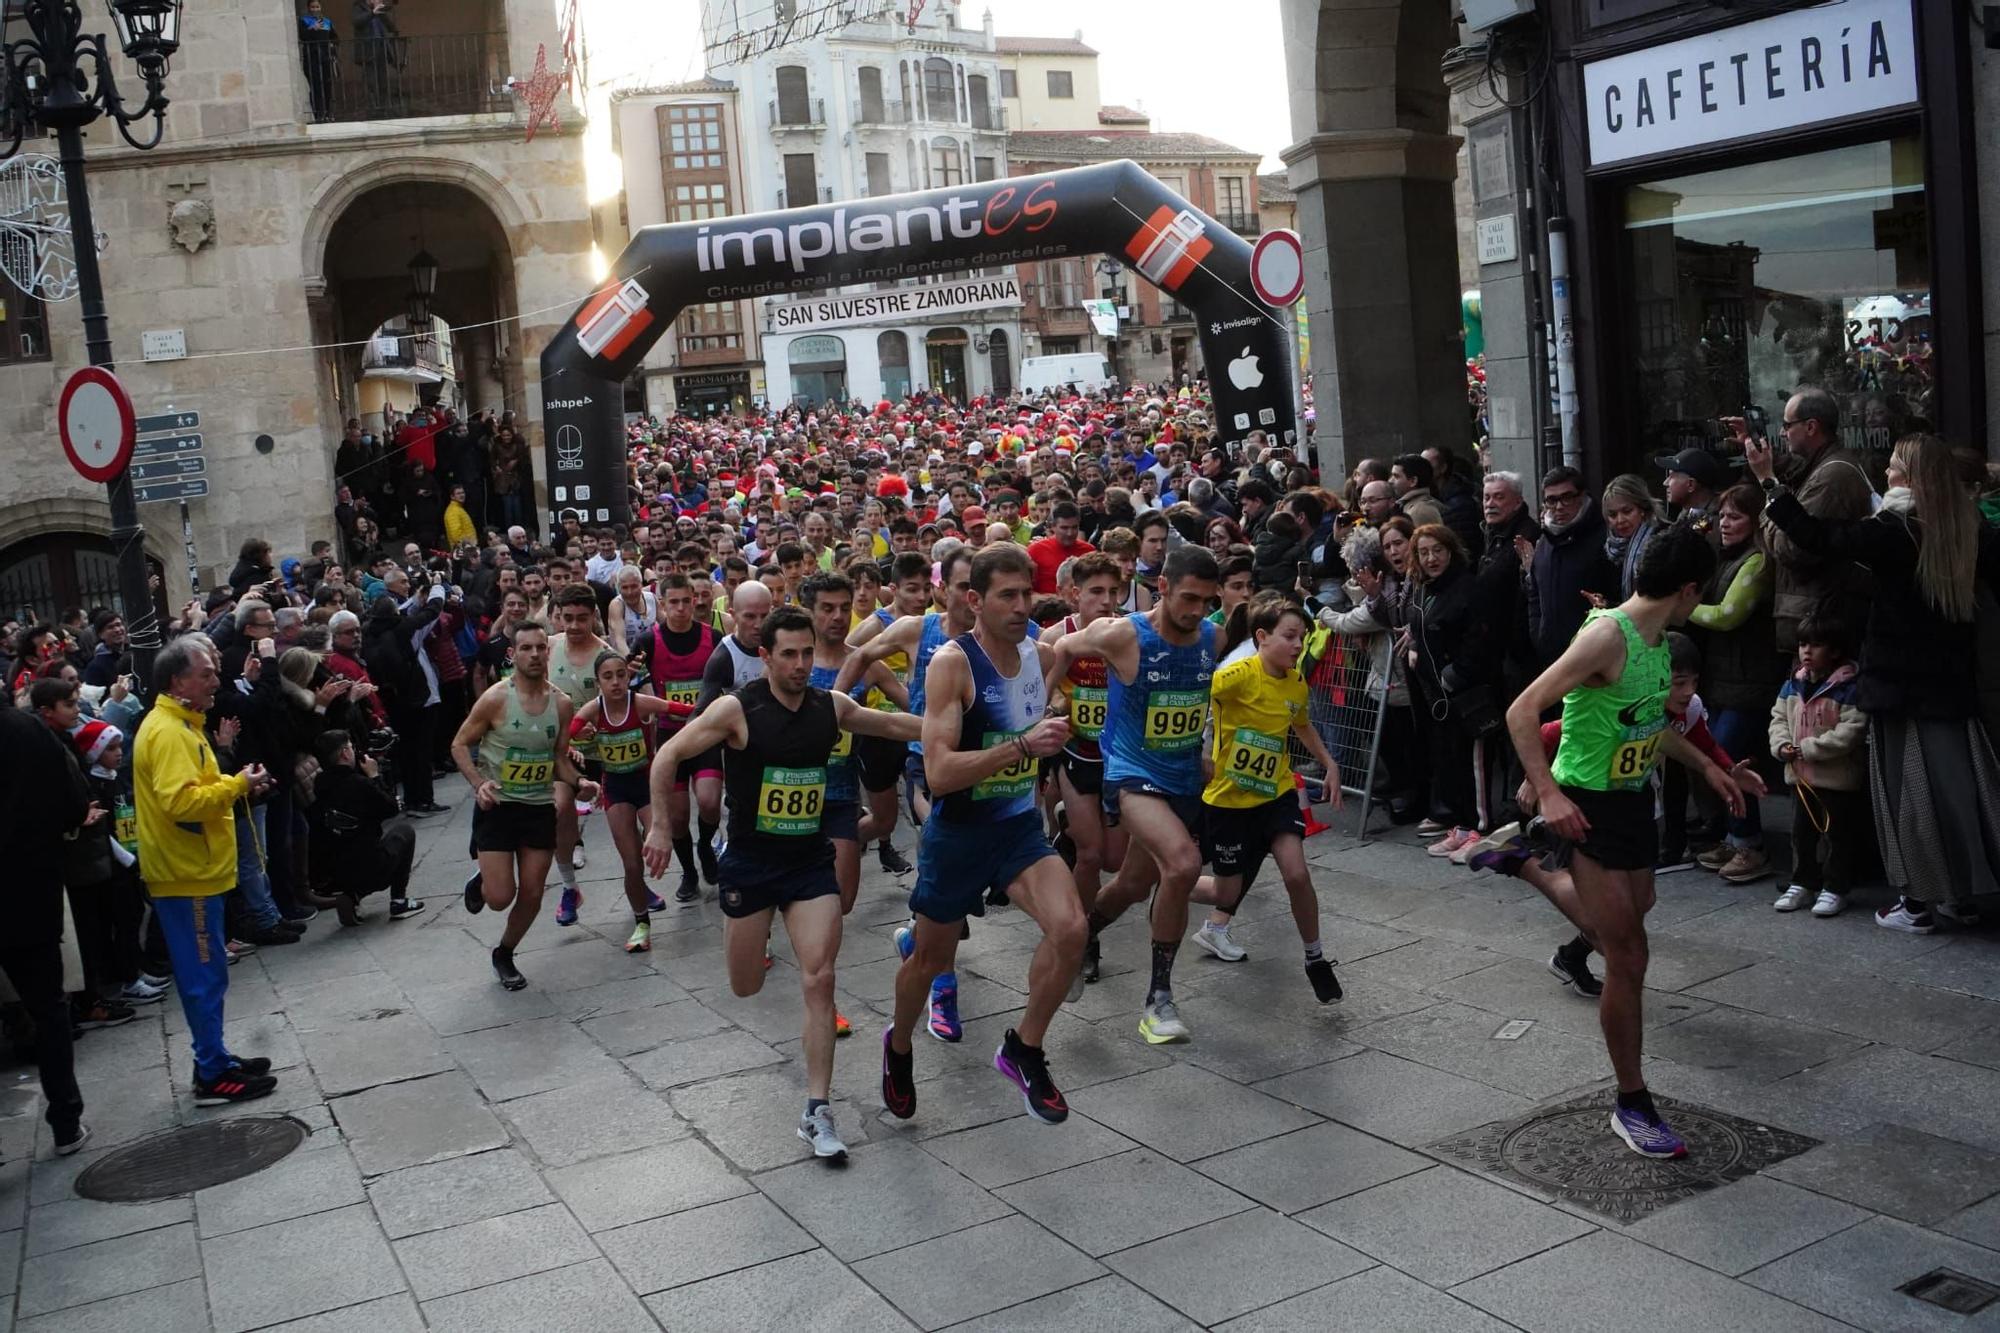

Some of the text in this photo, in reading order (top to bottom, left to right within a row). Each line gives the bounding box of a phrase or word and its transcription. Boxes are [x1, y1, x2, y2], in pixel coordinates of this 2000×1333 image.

[697, 180, 1057, 273] implantes
[857, 256, 965, 281] implantes
[972, 244, 1067, 264] dentales
[777, 280, 1018, 327] SAN SILVESTRE ZAMORANA
[1223, 316, 1261, 330] invisalign
[1844, 427, 1890, 449] MAYOR
[557, 459, 584, 469] DSD
[1153, 709, 1201, 735] 996
[604, 743, 641, 761] 279
[1233, 748, 1277, 778] 949
[509, 764, 547, 782] 748
[767, 789, 819, 816] 688
